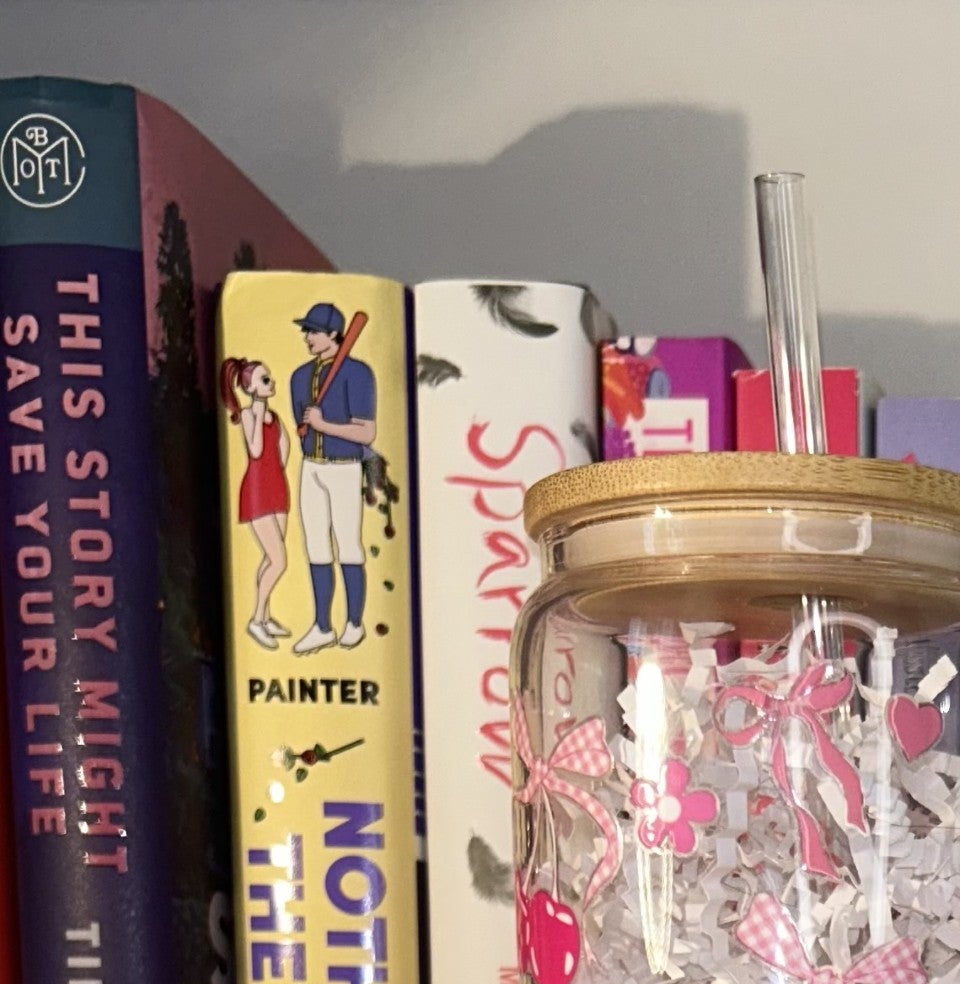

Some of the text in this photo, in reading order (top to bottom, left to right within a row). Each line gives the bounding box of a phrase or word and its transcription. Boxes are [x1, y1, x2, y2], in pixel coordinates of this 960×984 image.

[3, 314, 67, 836] SAVE YOUR LIFE
[56, 273, 128, 874] THIS STORY MIGHT
[248, 678, 380, 705] PAINTER
[247, 834, 308, 983] THE
